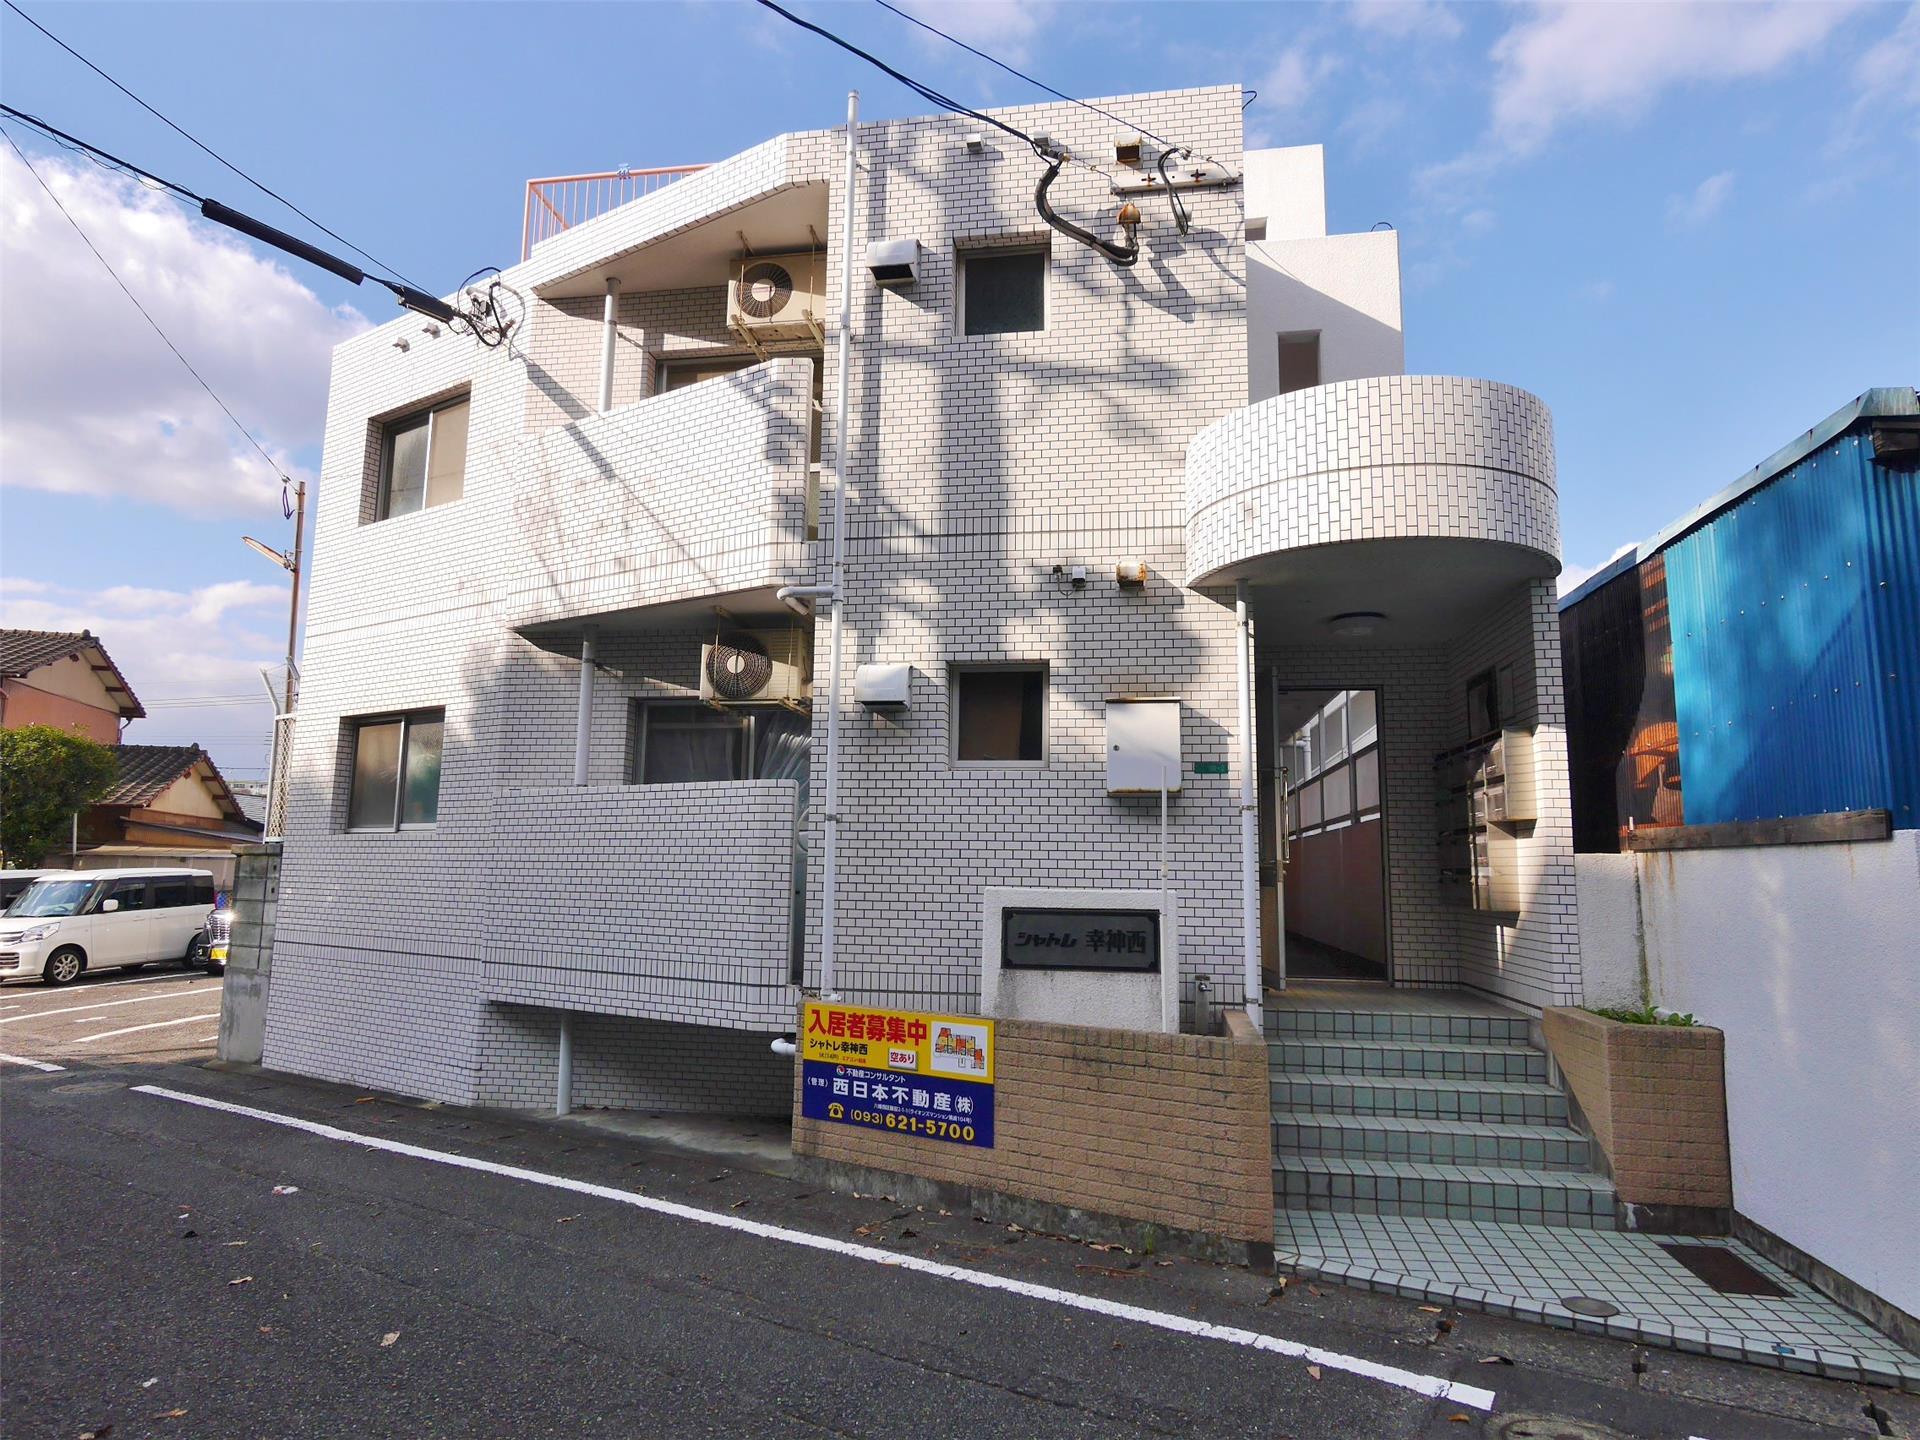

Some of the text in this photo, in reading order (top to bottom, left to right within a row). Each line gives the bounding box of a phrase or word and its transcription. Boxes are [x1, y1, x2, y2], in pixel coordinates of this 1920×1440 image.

[1086, 928, 1147, 954] 幸神西
[808, 1008, 927, 1046] 入居者募集中
[809, 1038, 869, 1056] シャトレ幸神西
[889, 1051, 915, 1065] 空あり
[845, 1067, 907, 1084] 不動産コンサルタント
